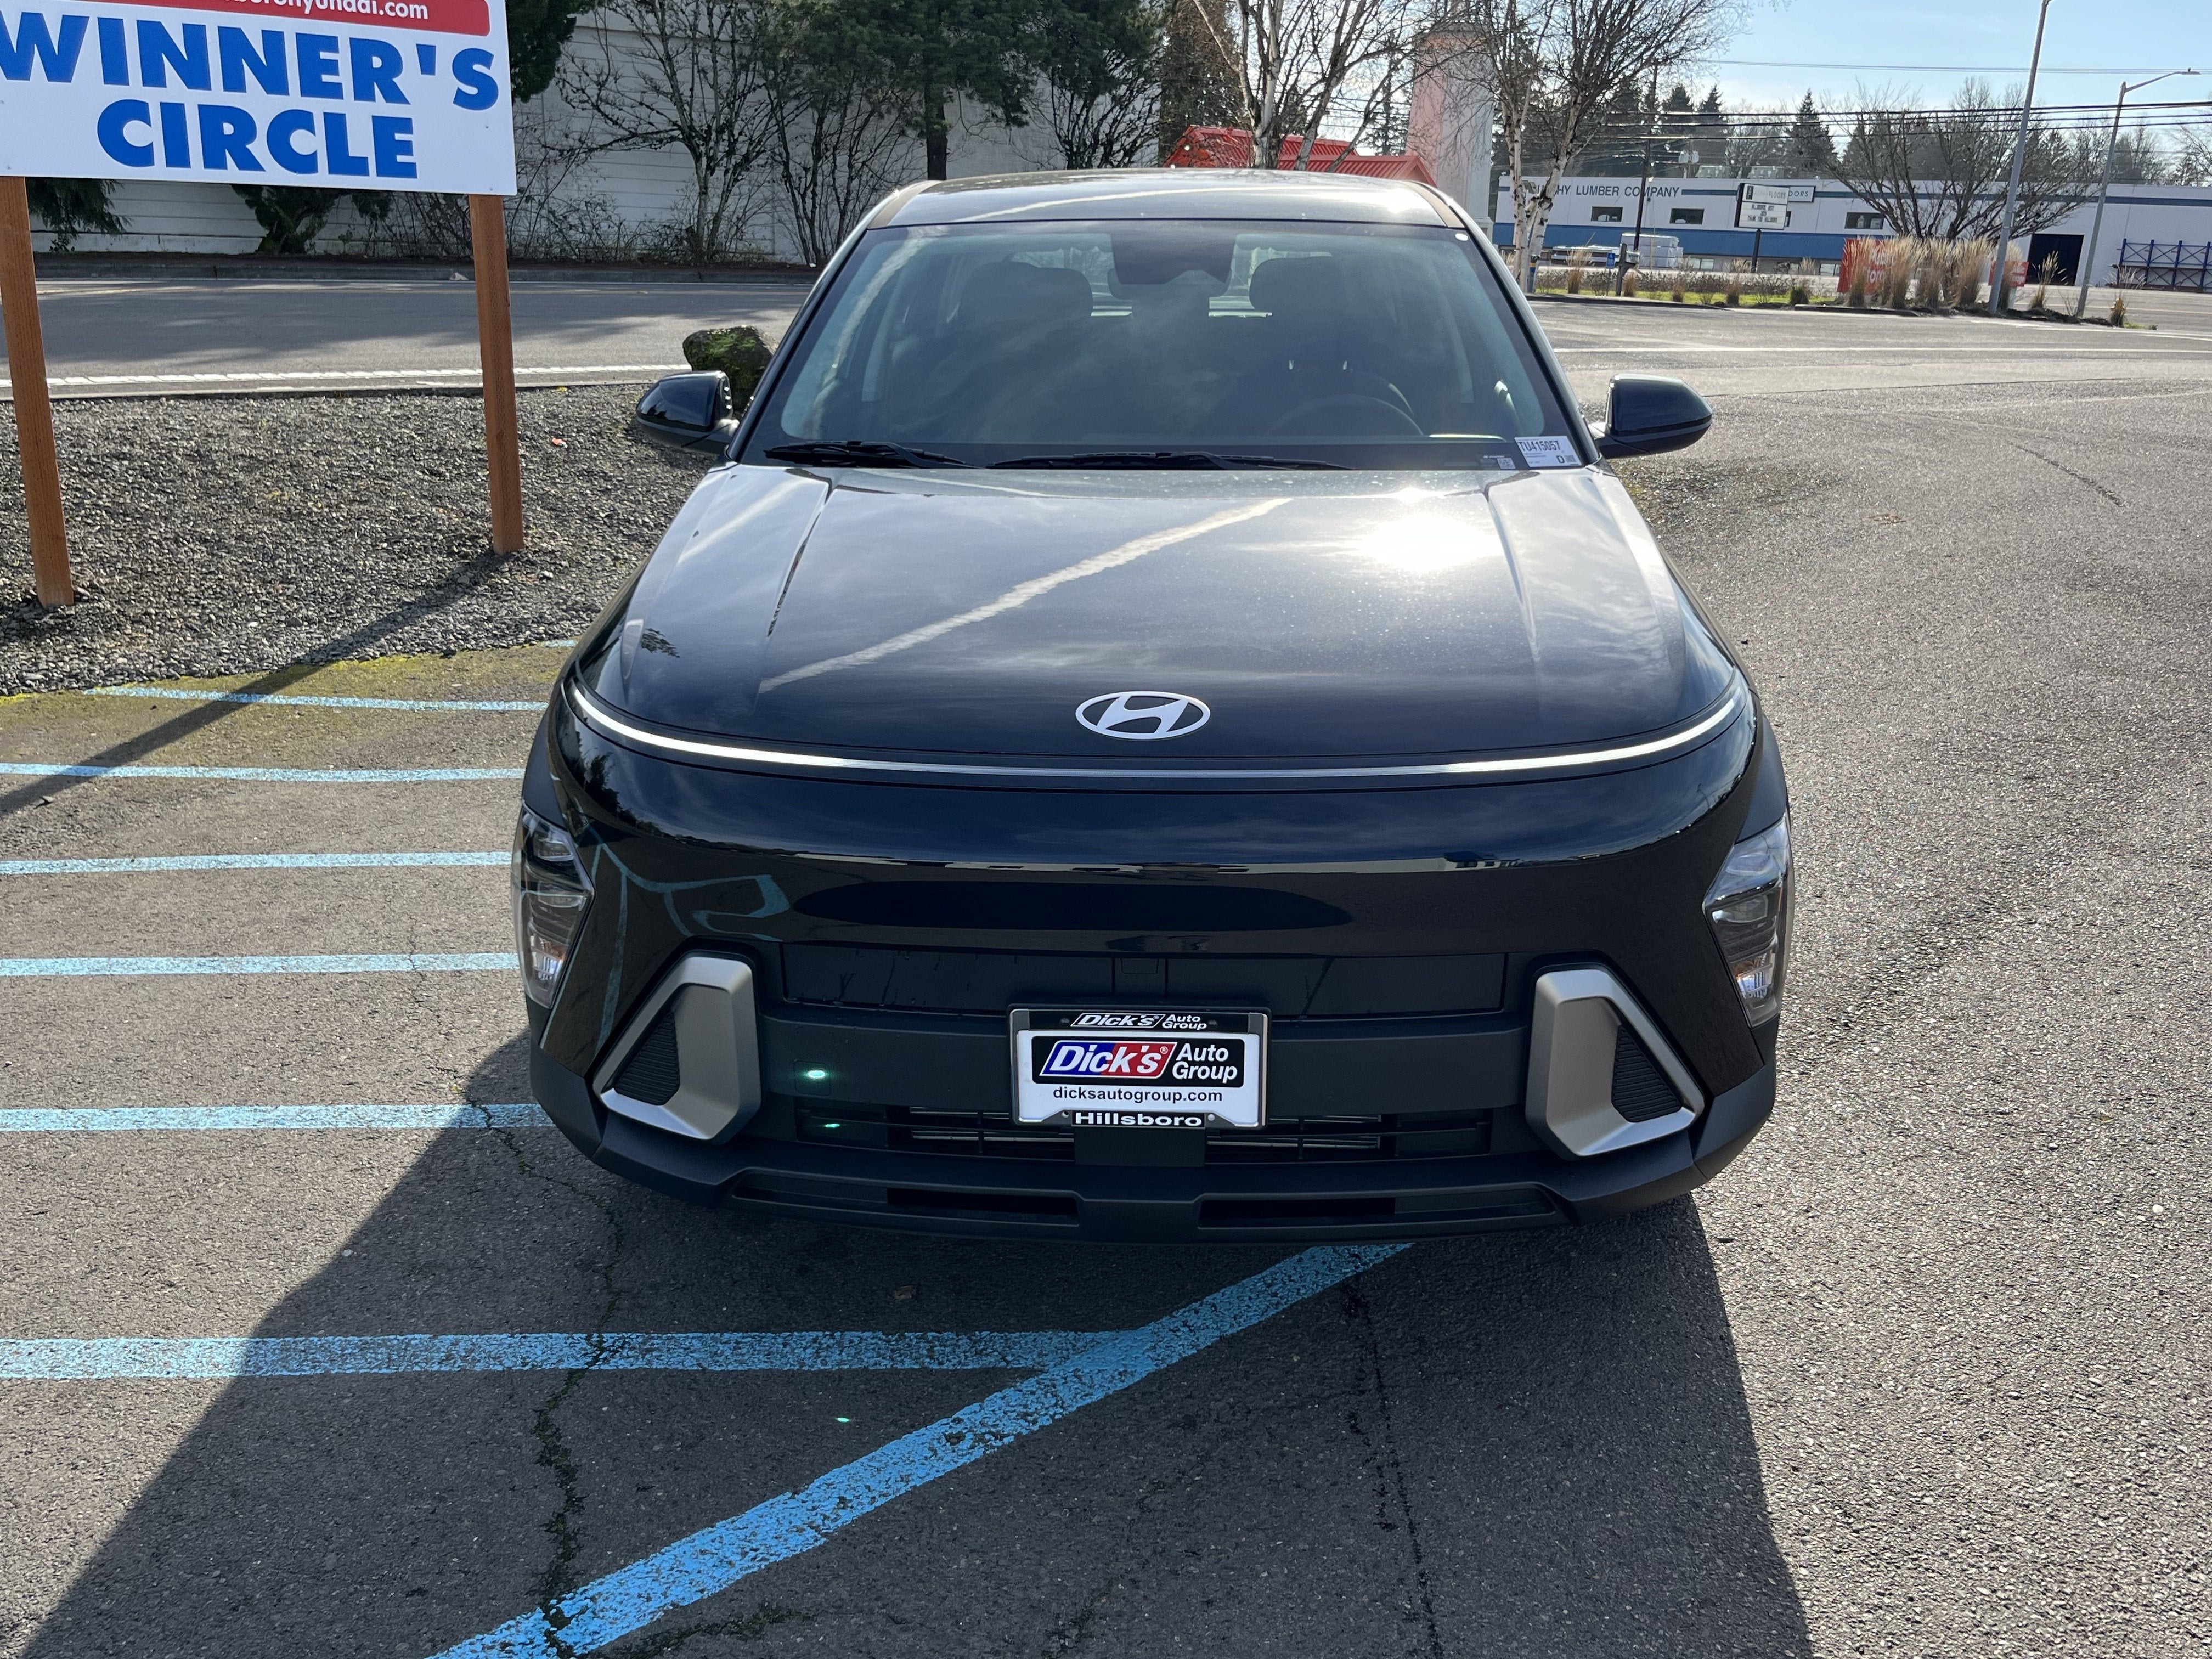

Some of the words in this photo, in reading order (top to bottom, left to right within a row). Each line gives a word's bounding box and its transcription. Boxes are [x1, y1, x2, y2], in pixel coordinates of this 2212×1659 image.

[0, 12, 499, 110] WINNER'S
[97, 99, 417, 179] CIRCLE
[1576, 185, 1619, 196] LUMBER
[1517, 441, 1561, 452] TU415057
[1077, 1014, 1155, 1027] Dick's
[1161, 1021, 1207, 1031] Group
[1165, 1014, 1201, 1023] Auto
[1049, 1044, 1161, 1074] Dick's
[1176, 1043, 1229, 1062] Auto
[1172, 1061, 1238, 1084] Group
[1053, 1086, 1223, 1104] dicksautogroup.com
[1075, 1112, 1203, 1127] Hillsboro
